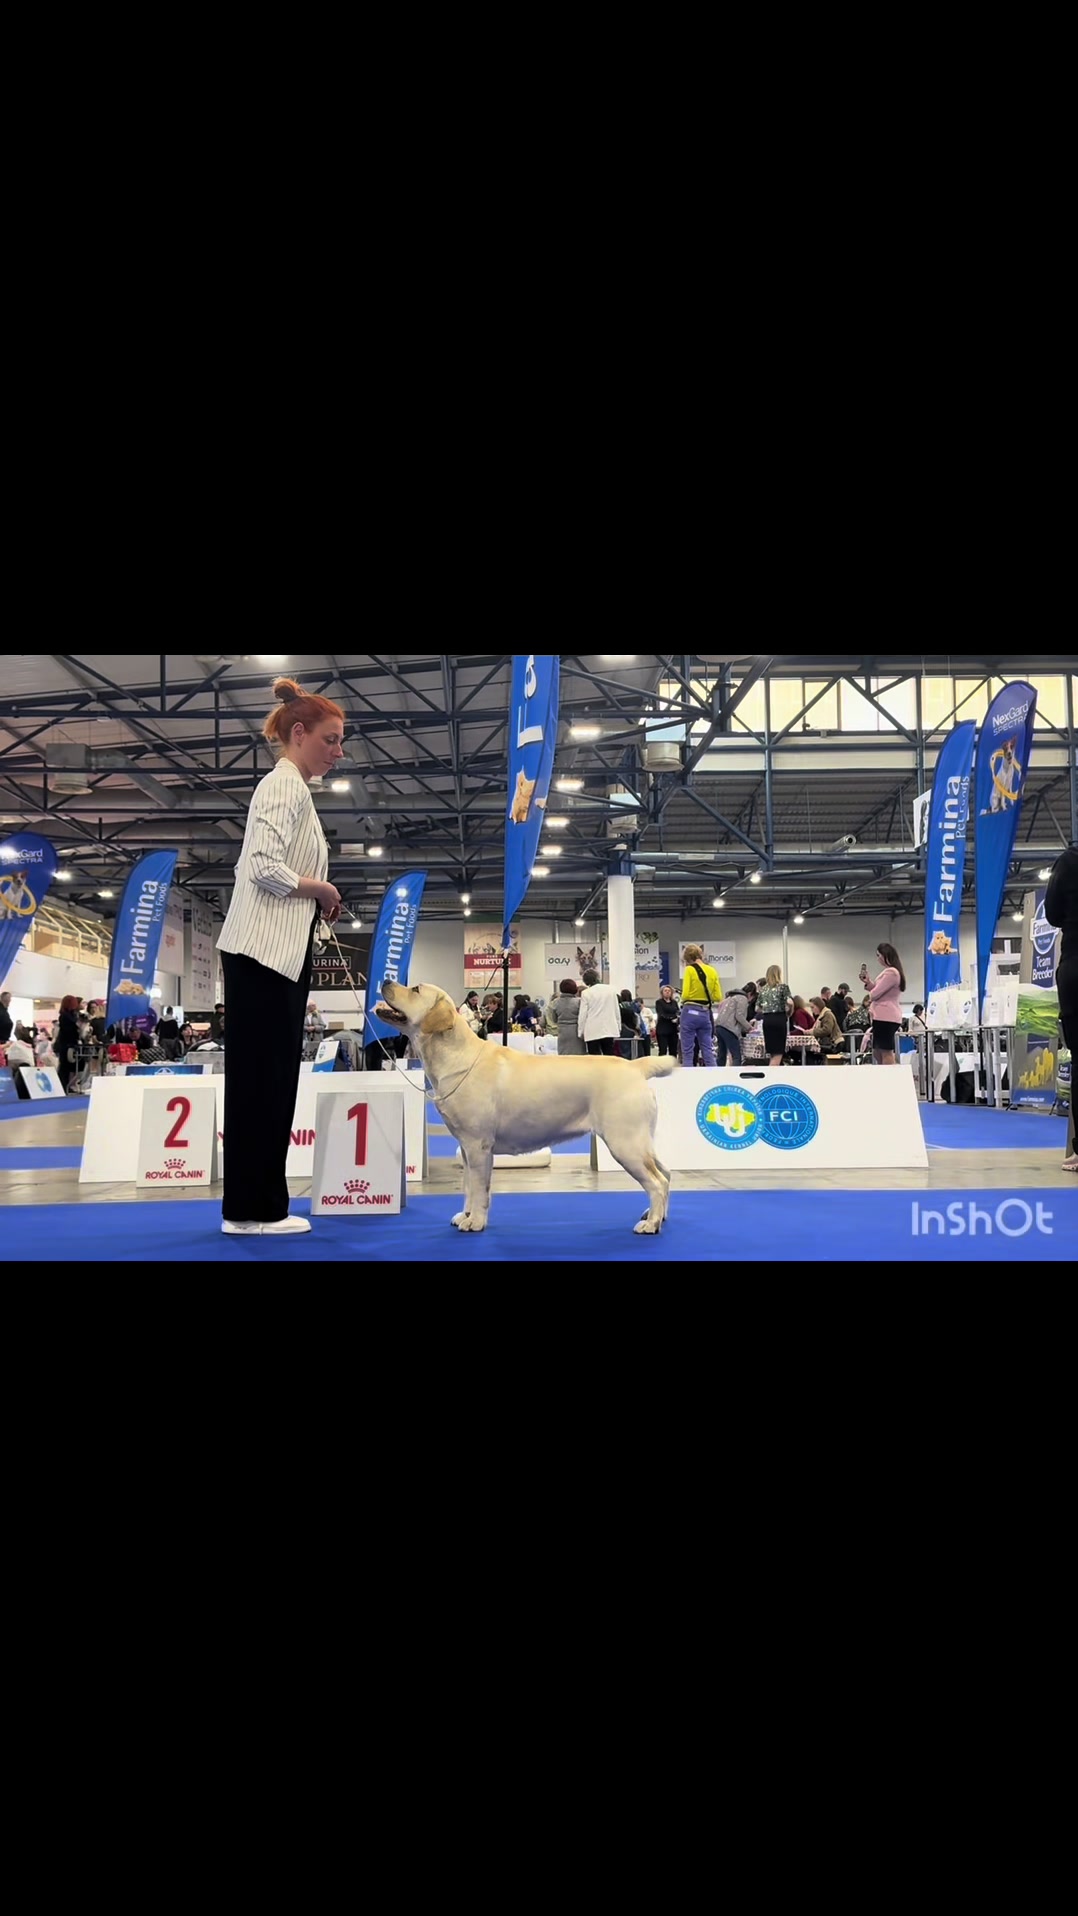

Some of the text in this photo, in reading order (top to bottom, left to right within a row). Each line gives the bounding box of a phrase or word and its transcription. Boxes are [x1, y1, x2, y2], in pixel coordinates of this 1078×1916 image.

[992, 700, 1029, 728] NexGard
[933, 775, 961, 922] Farmina
[1, 857, 43, 865] SPECTRA
[151, 882, 168, 922] Pet Foods
[120, 880, 159, 975] Farmina
[312, 958, 348, 967] URINA
[473, 958, 512, 966] NURTU
[1036, 955, 1051, 968] Team
[317, 971, 368, 987] PLAN
[1033, 967, 1053, 980] Breeder
[164, 1096, 190, 1148] 2
[769, 1111, 798, 1122] FCI
[289, 1129, 316, 1146] NIN
[347, 1102, 368, 1166] 1
[145, 1170, 204, 1180] ROYAL CANIN
[321, 1194, 392, 1206] ROYAL CANIN
